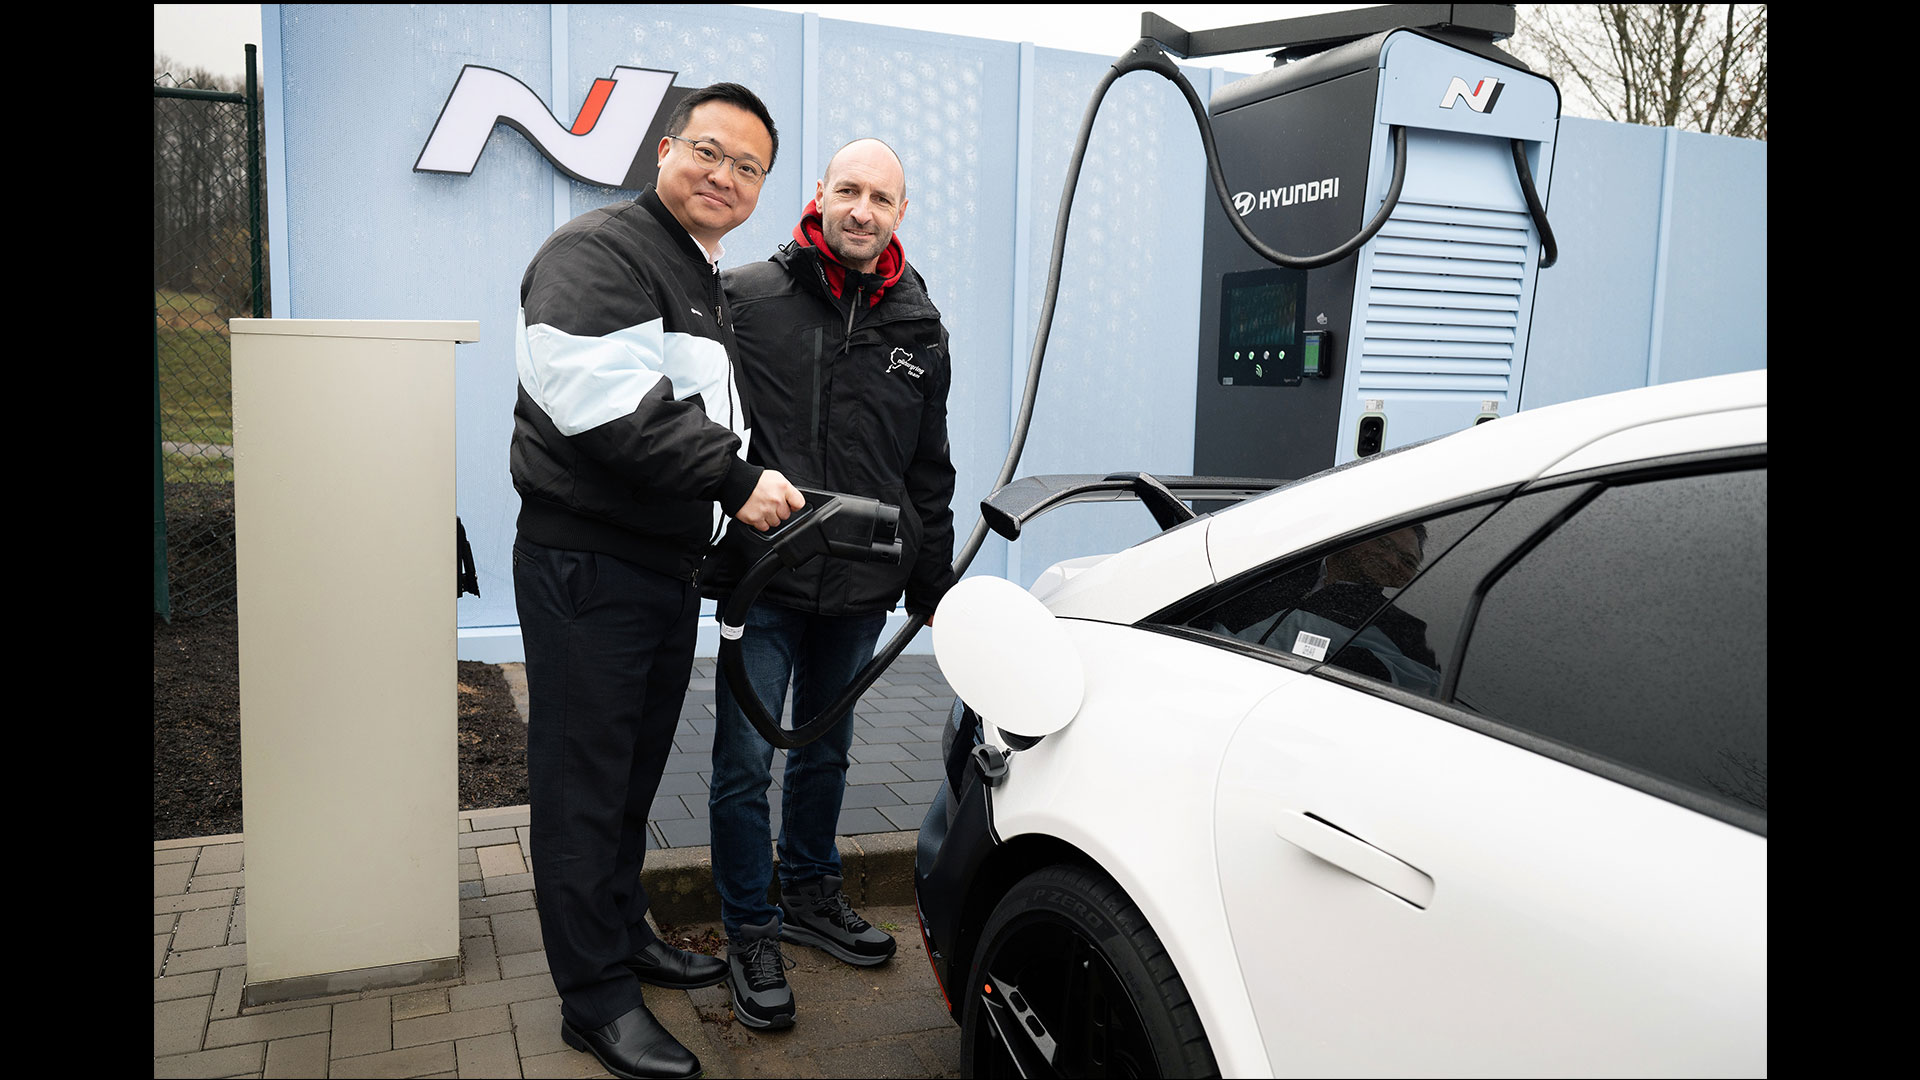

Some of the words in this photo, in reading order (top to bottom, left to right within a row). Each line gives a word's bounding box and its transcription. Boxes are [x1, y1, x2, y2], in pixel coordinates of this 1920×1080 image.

[1439, 76, 1505, 114] N
[413, 64, 684, 189] N
[1259, 177, 1340, 210] HYUNDAI
[1033, 889, 1046, 901] P
[1048, 891, 1104, 929] ZERO
